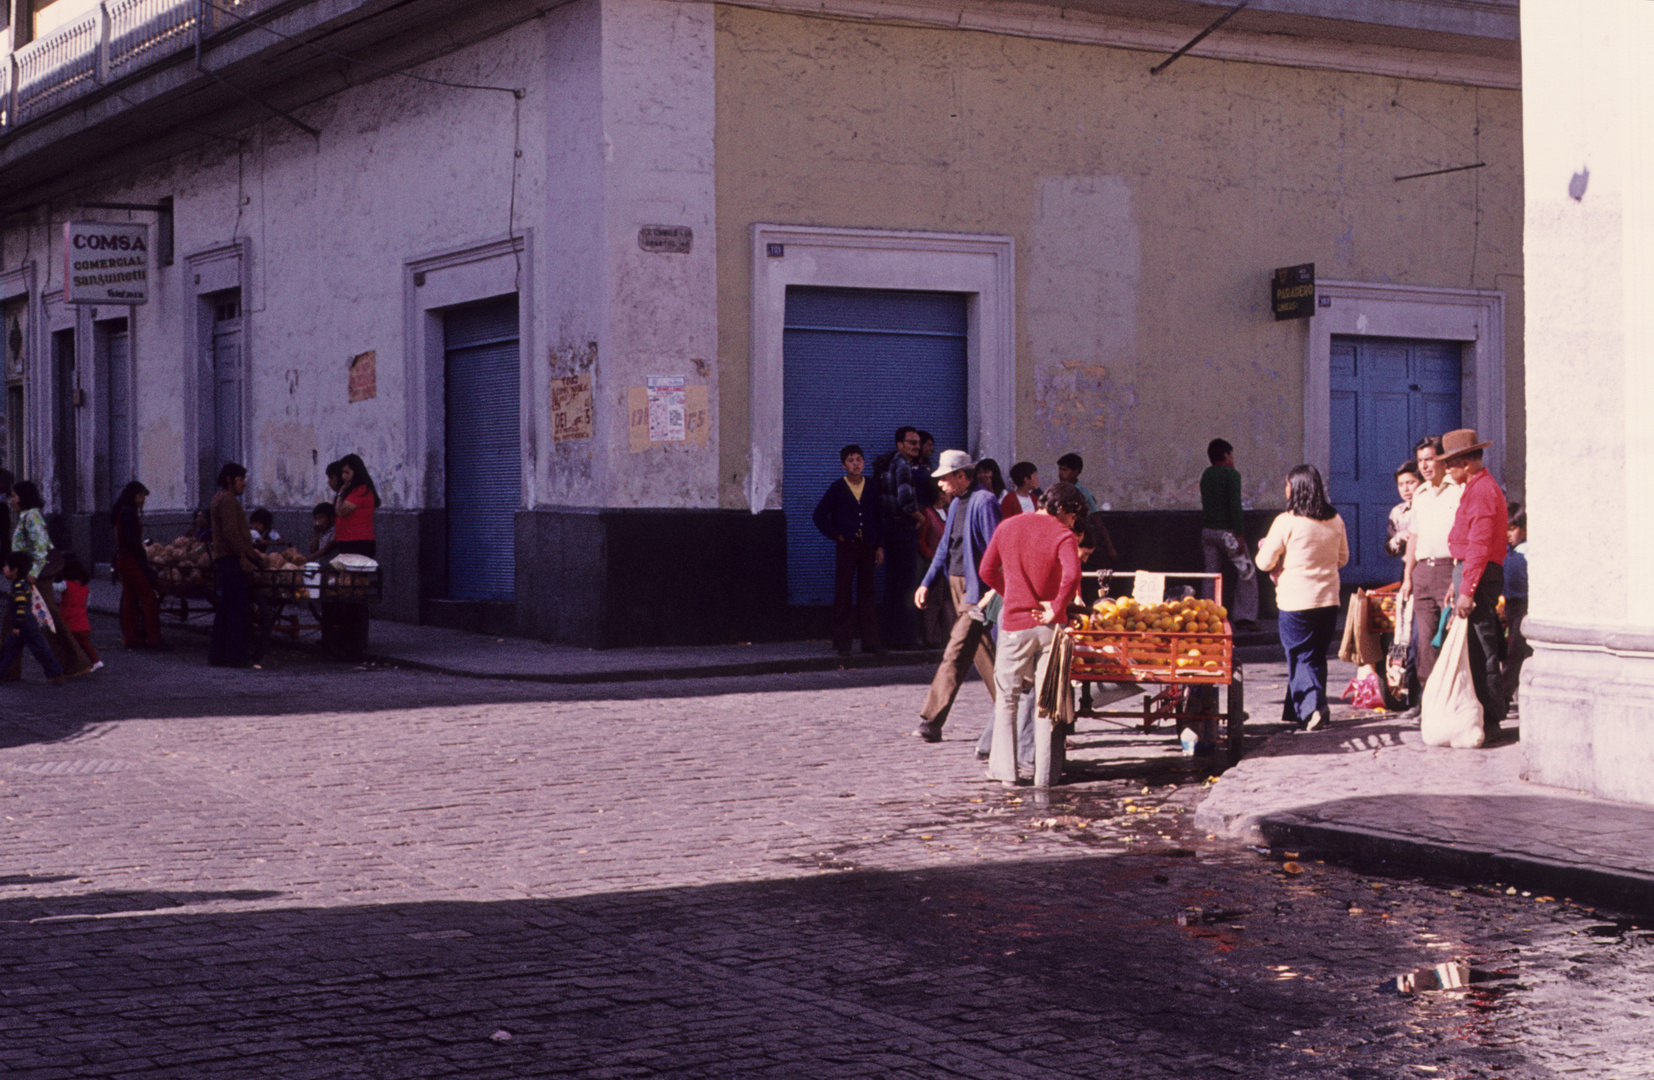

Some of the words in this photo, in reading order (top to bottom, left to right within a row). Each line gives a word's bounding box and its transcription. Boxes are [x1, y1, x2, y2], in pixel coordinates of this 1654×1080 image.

[73, 234, 146, 251] COMSA
[74, 256, 145, 271] COMERCIAL
[1276, 284, 1314, 300] PARADERO
